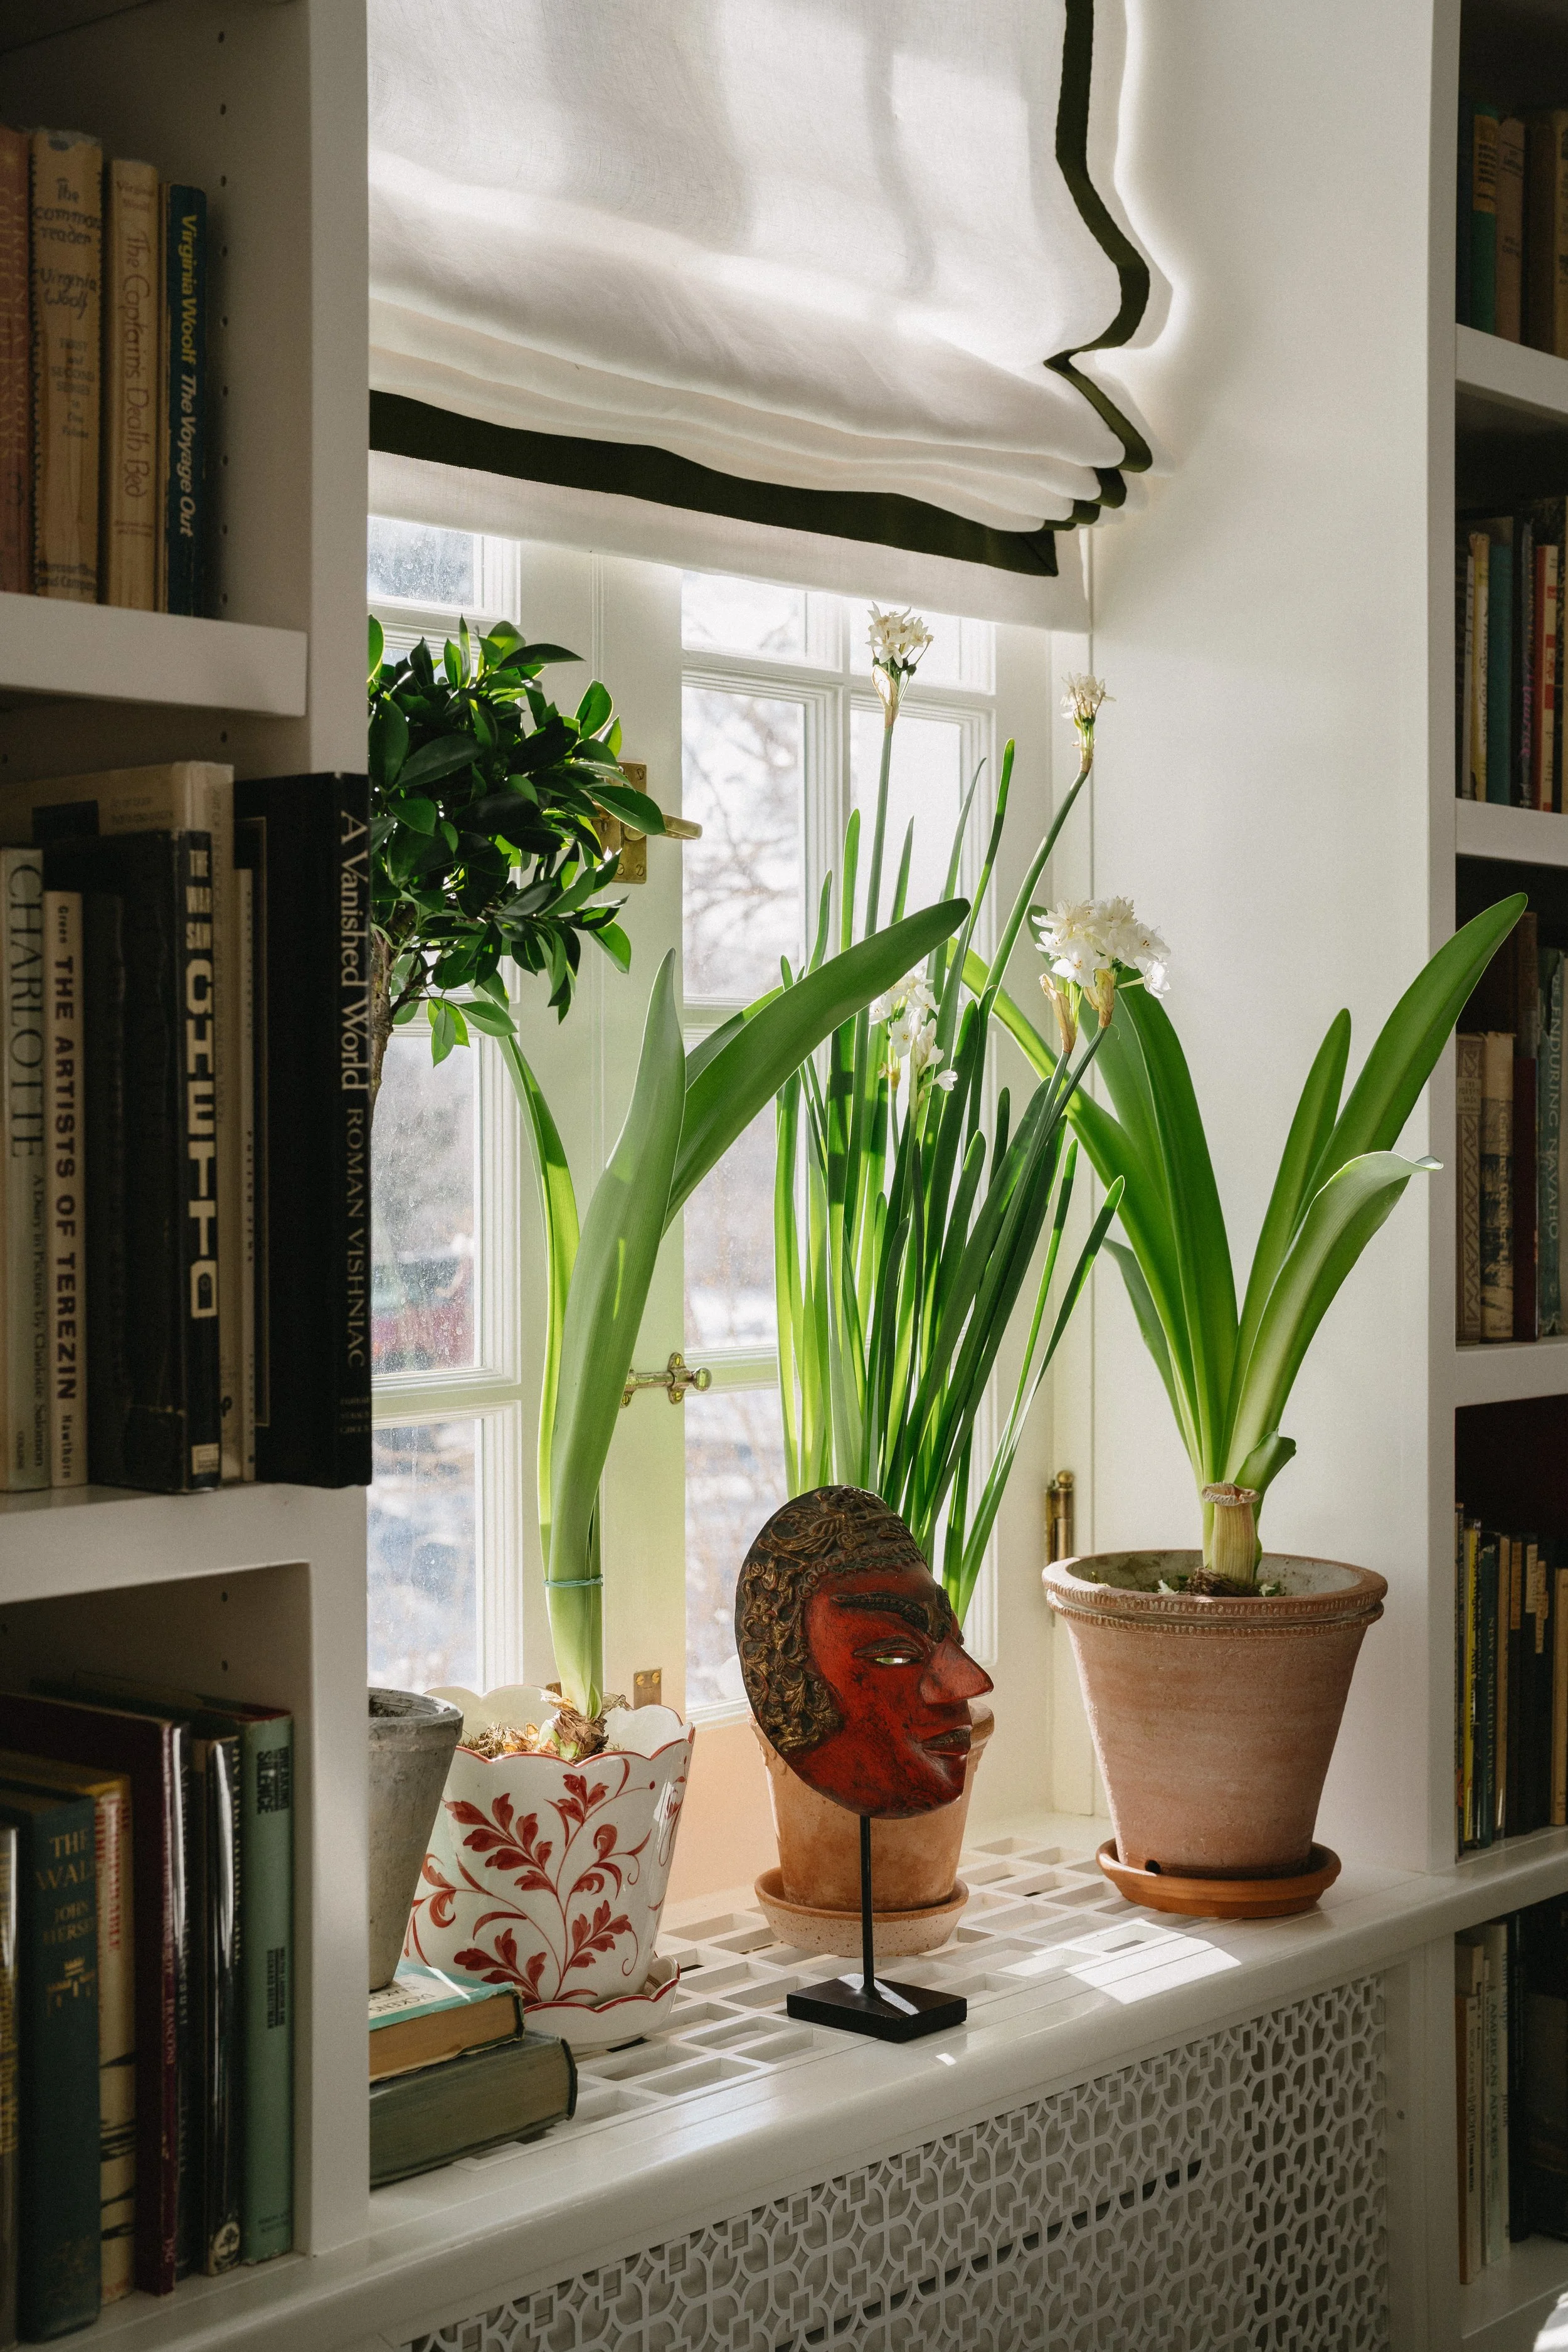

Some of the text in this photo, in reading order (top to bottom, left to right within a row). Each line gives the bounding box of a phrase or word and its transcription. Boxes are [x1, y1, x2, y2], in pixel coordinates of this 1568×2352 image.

[57, 177, 79, 202] The
[127, 231, 151, 268] The
[176, 215, 198, 538] Virginia Woolf The Voyage Out
[126, 387, 151, 452] Death
[124, 458, 151, 498] Bed
[9, 864, 43, 1158] CHARLOTTE
[55, 955, 73, 1020] THE
[56, 1036, 75, 1178] ARTISTS
[340, 810, 369, 1369] A Vanished World ROMAN VISHNIAC
[1550, 1006, 1561, 1127] ENDURING
[186, 958, 218, 1319] GHETTO
[56, 1194, 76, 1237] OF
[1548, 1138, 1559, 1239] NAVAHO
[57, 1251, 76, 1400] TEREZIN
[257, 1750, 274, 1814] SILENCE
[368, 1992, 435, 2012] DICKENS
